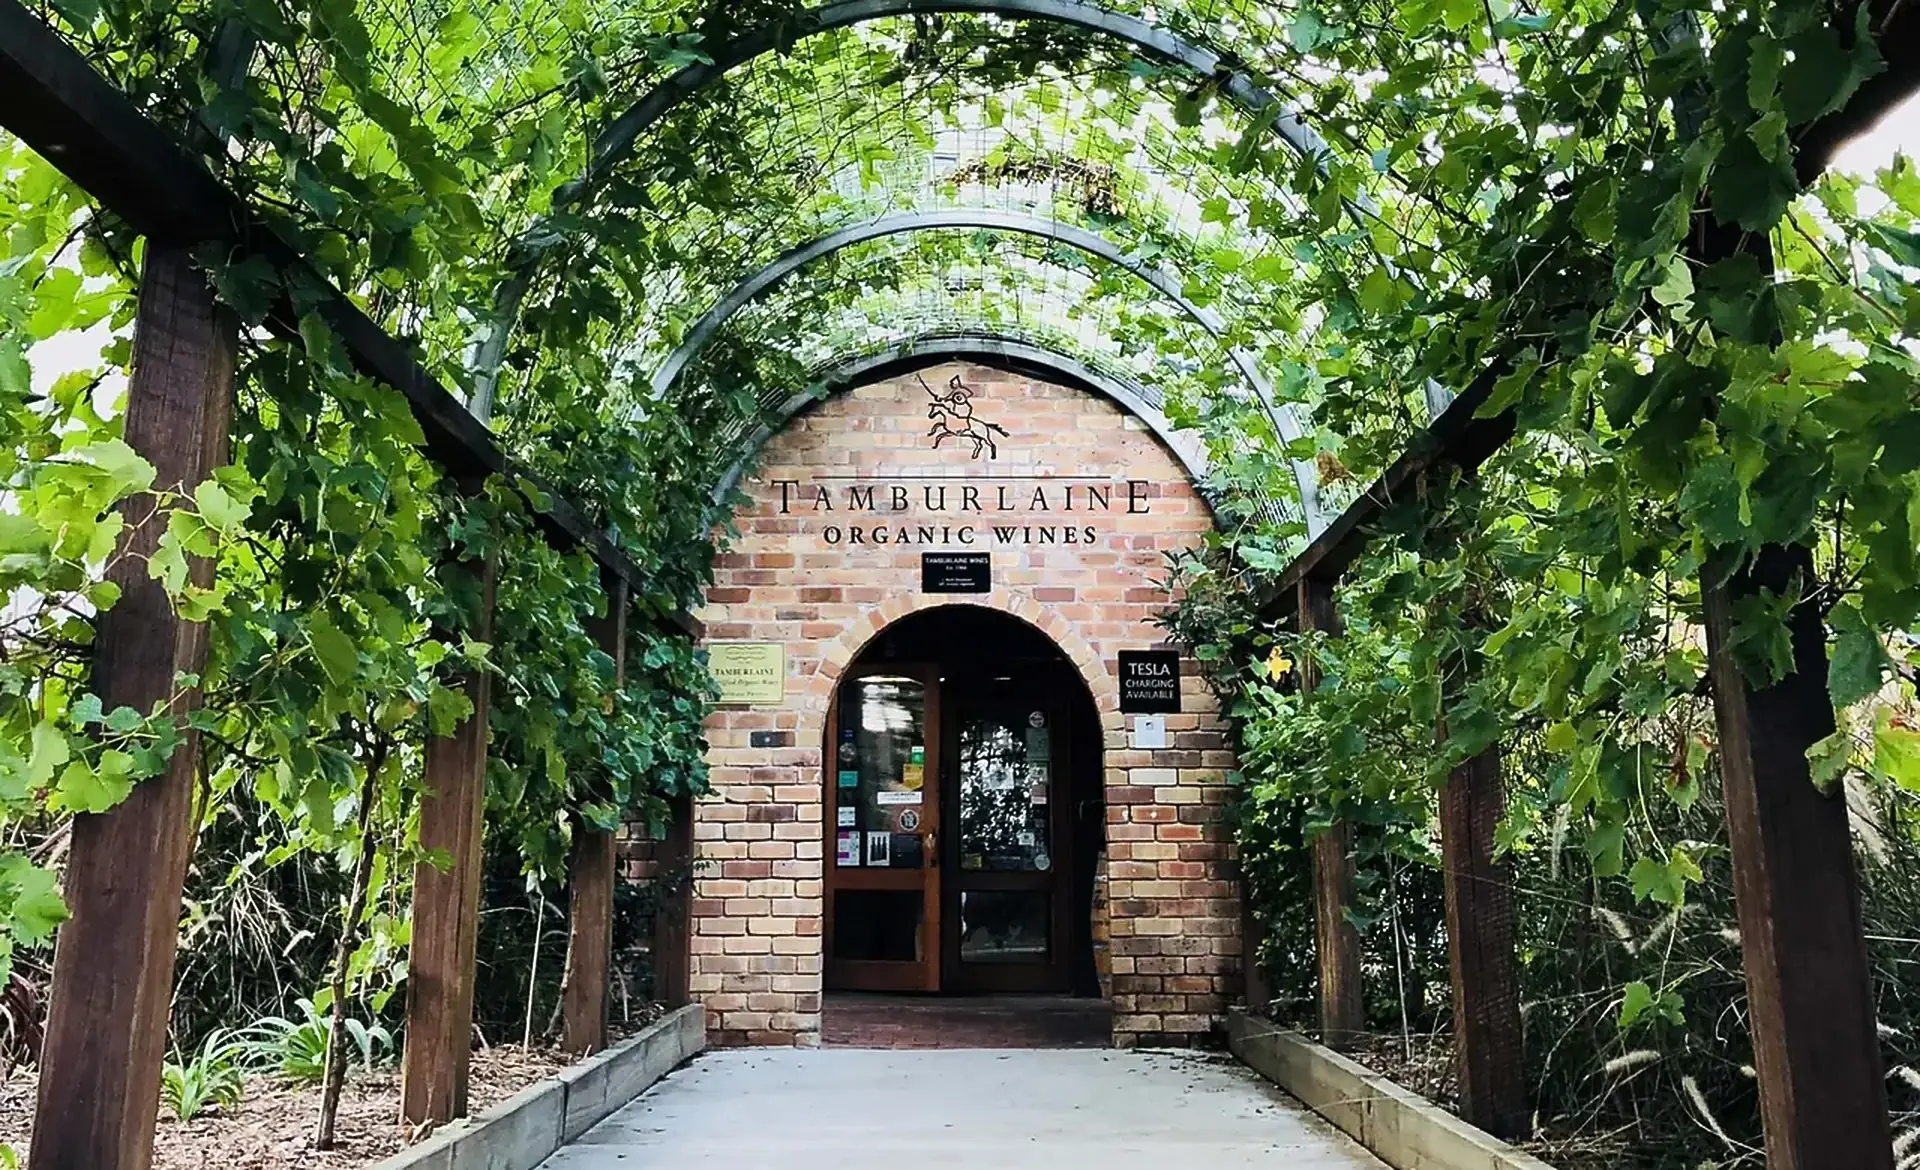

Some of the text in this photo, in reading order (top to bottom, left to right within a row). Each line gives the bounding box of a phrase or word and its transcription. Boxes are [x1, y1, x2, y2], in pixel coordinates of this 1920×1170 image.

[771, 479, 1150, 514] TAMBURLAINE
[823, 526, 1097, 544] ORGANIC WINES
[1128, 662, 1171, 676] TESLA
[1125, 679, 1175, 689] CHARGING
[1126, 690, 1174, 699] AVAILABLE
